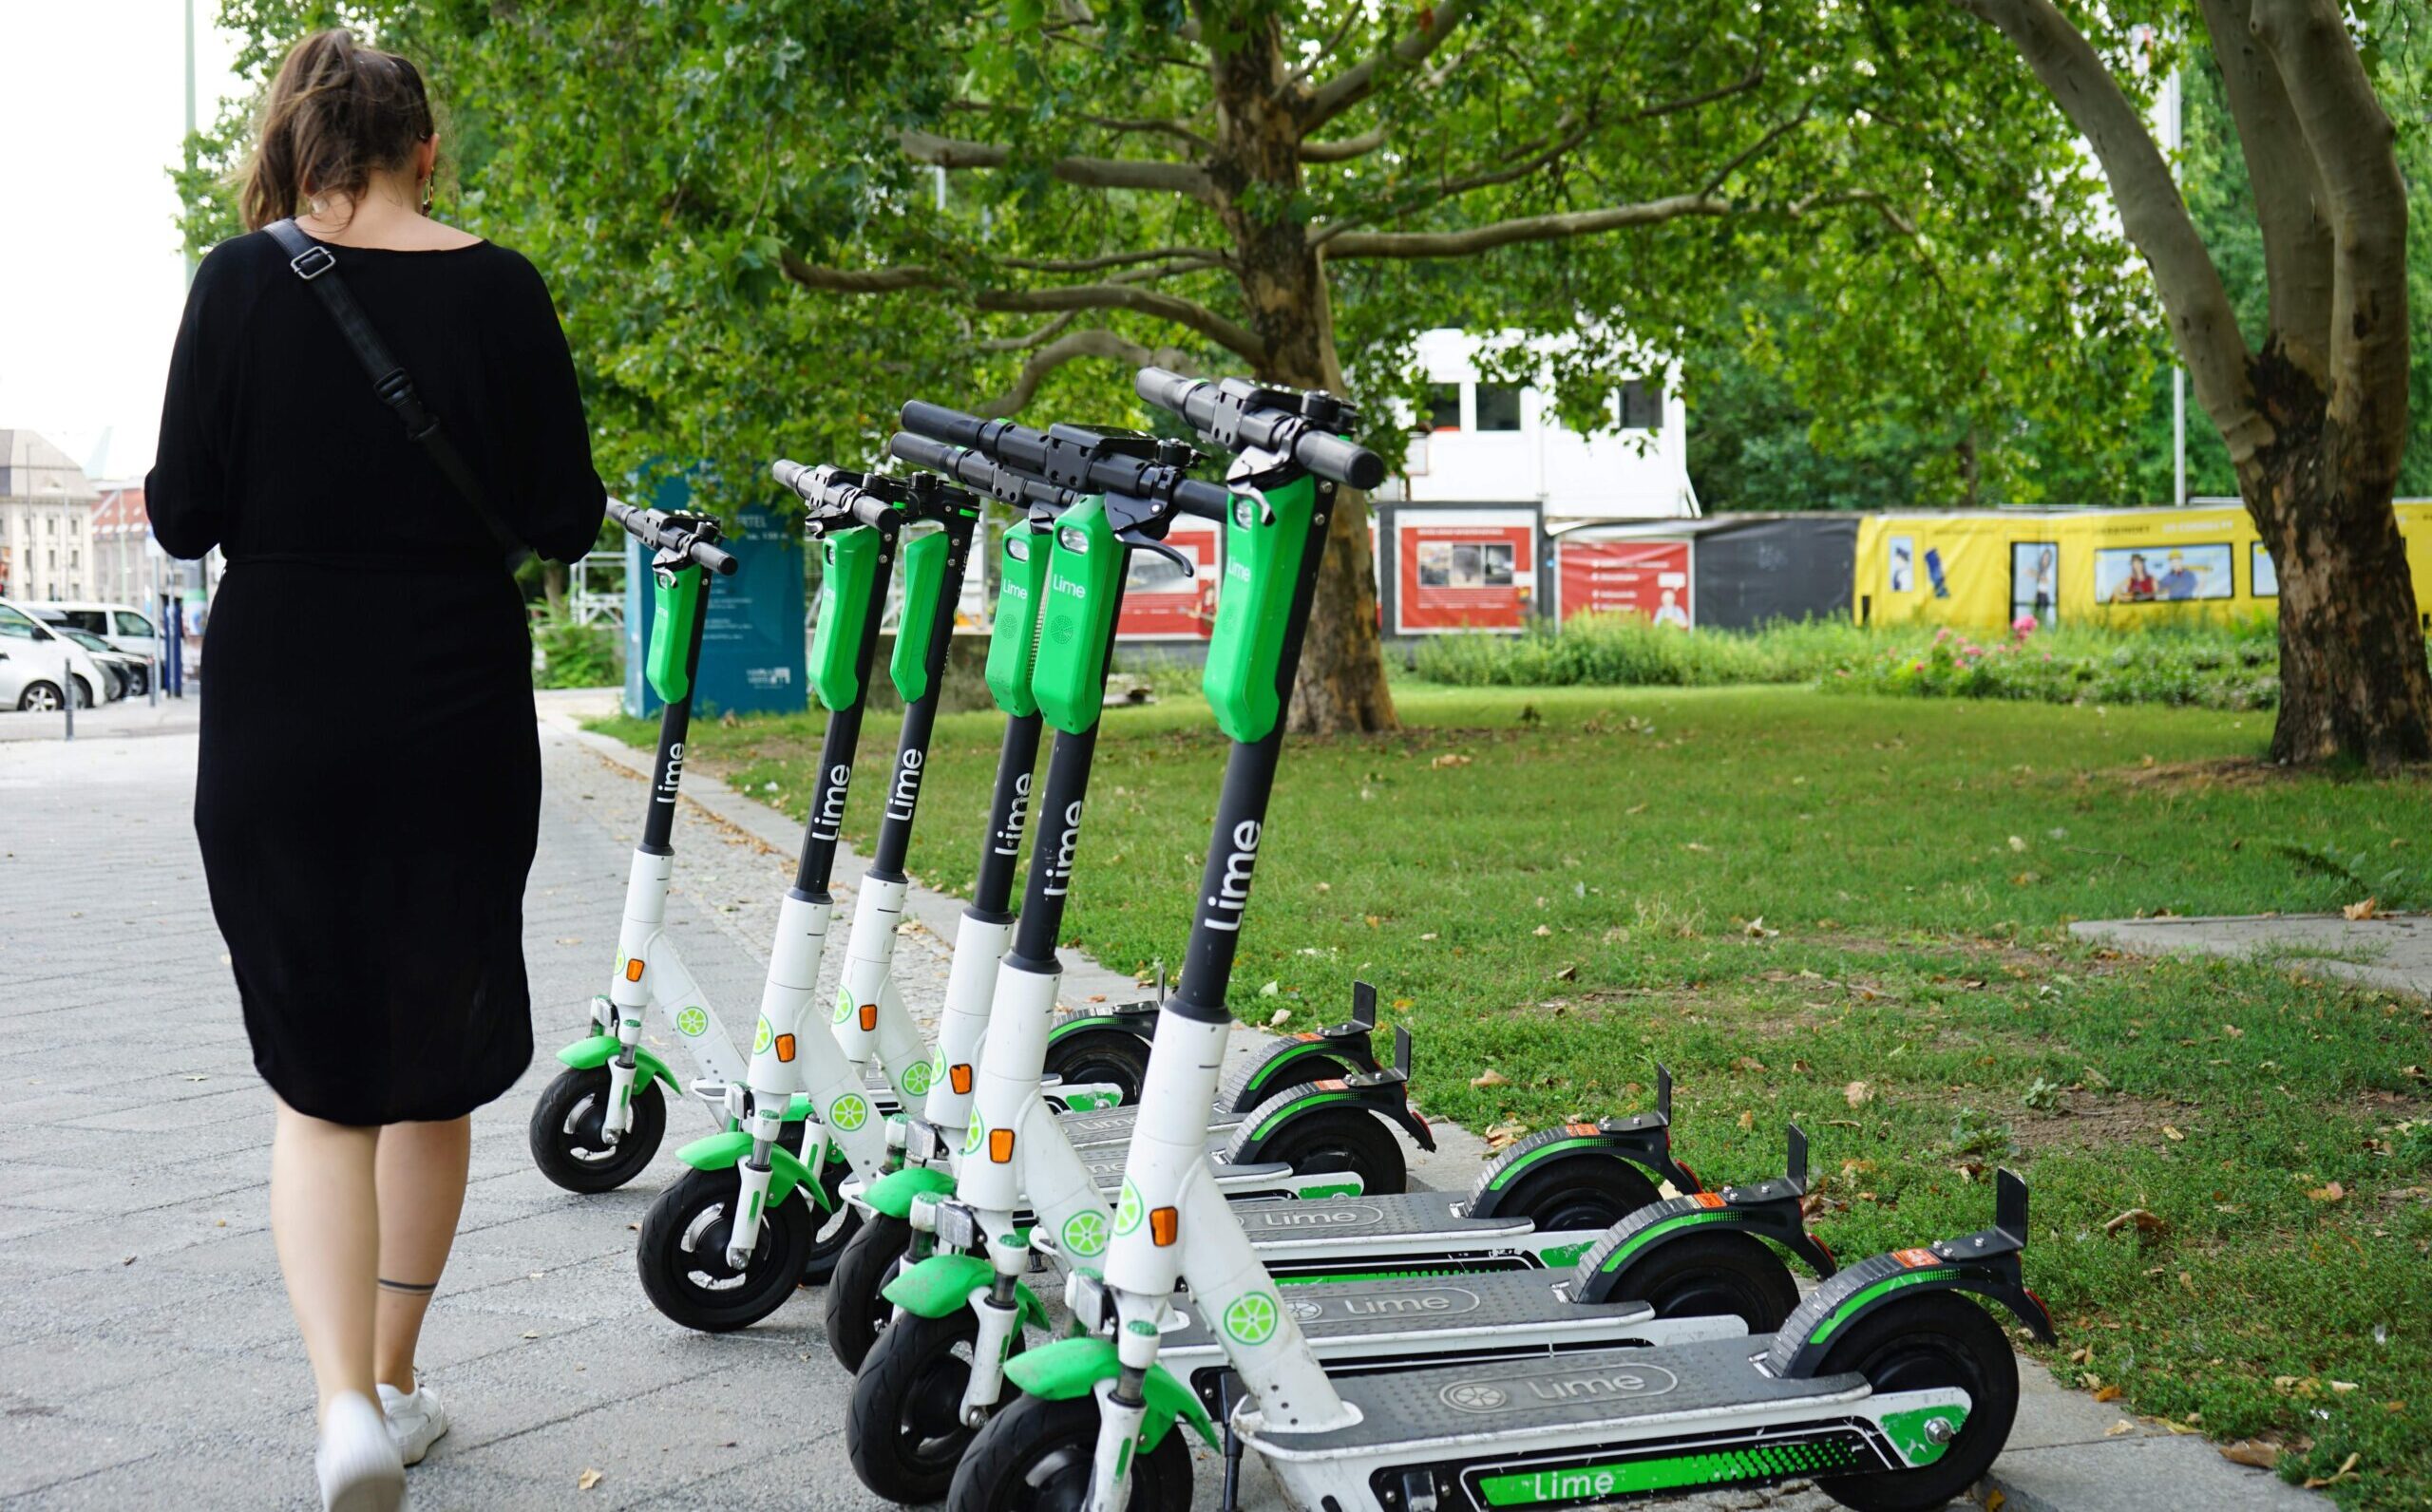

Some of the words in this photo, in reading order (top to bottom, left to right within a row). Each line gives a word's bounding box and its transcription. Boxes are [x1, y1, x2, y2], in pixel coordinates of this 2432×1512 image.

[1226, 555, 1251, 582] Lime
[1003, 579, 1028, 599] Lime
[1053, 574, 1086, 598] Lime
[656, 743, 685, 803] Lime
[886, 748, 923, 822] Lime
[811, 764, 851, 841] Lime
[995, 772, 1033, 856] Lime
[1043, 800, 1084, 897] Lime
[1204, 819, 1263, 932] Lime
[1076, 1118, 1136, 1130] Lim
[1265, 1212, 1358, 1226] Lime
[1345, 1296, 1450, 1314] Lime
[1526, 1375, 1645, 1401] Lime
[1534, 1471, 1614, 1501] Lime
